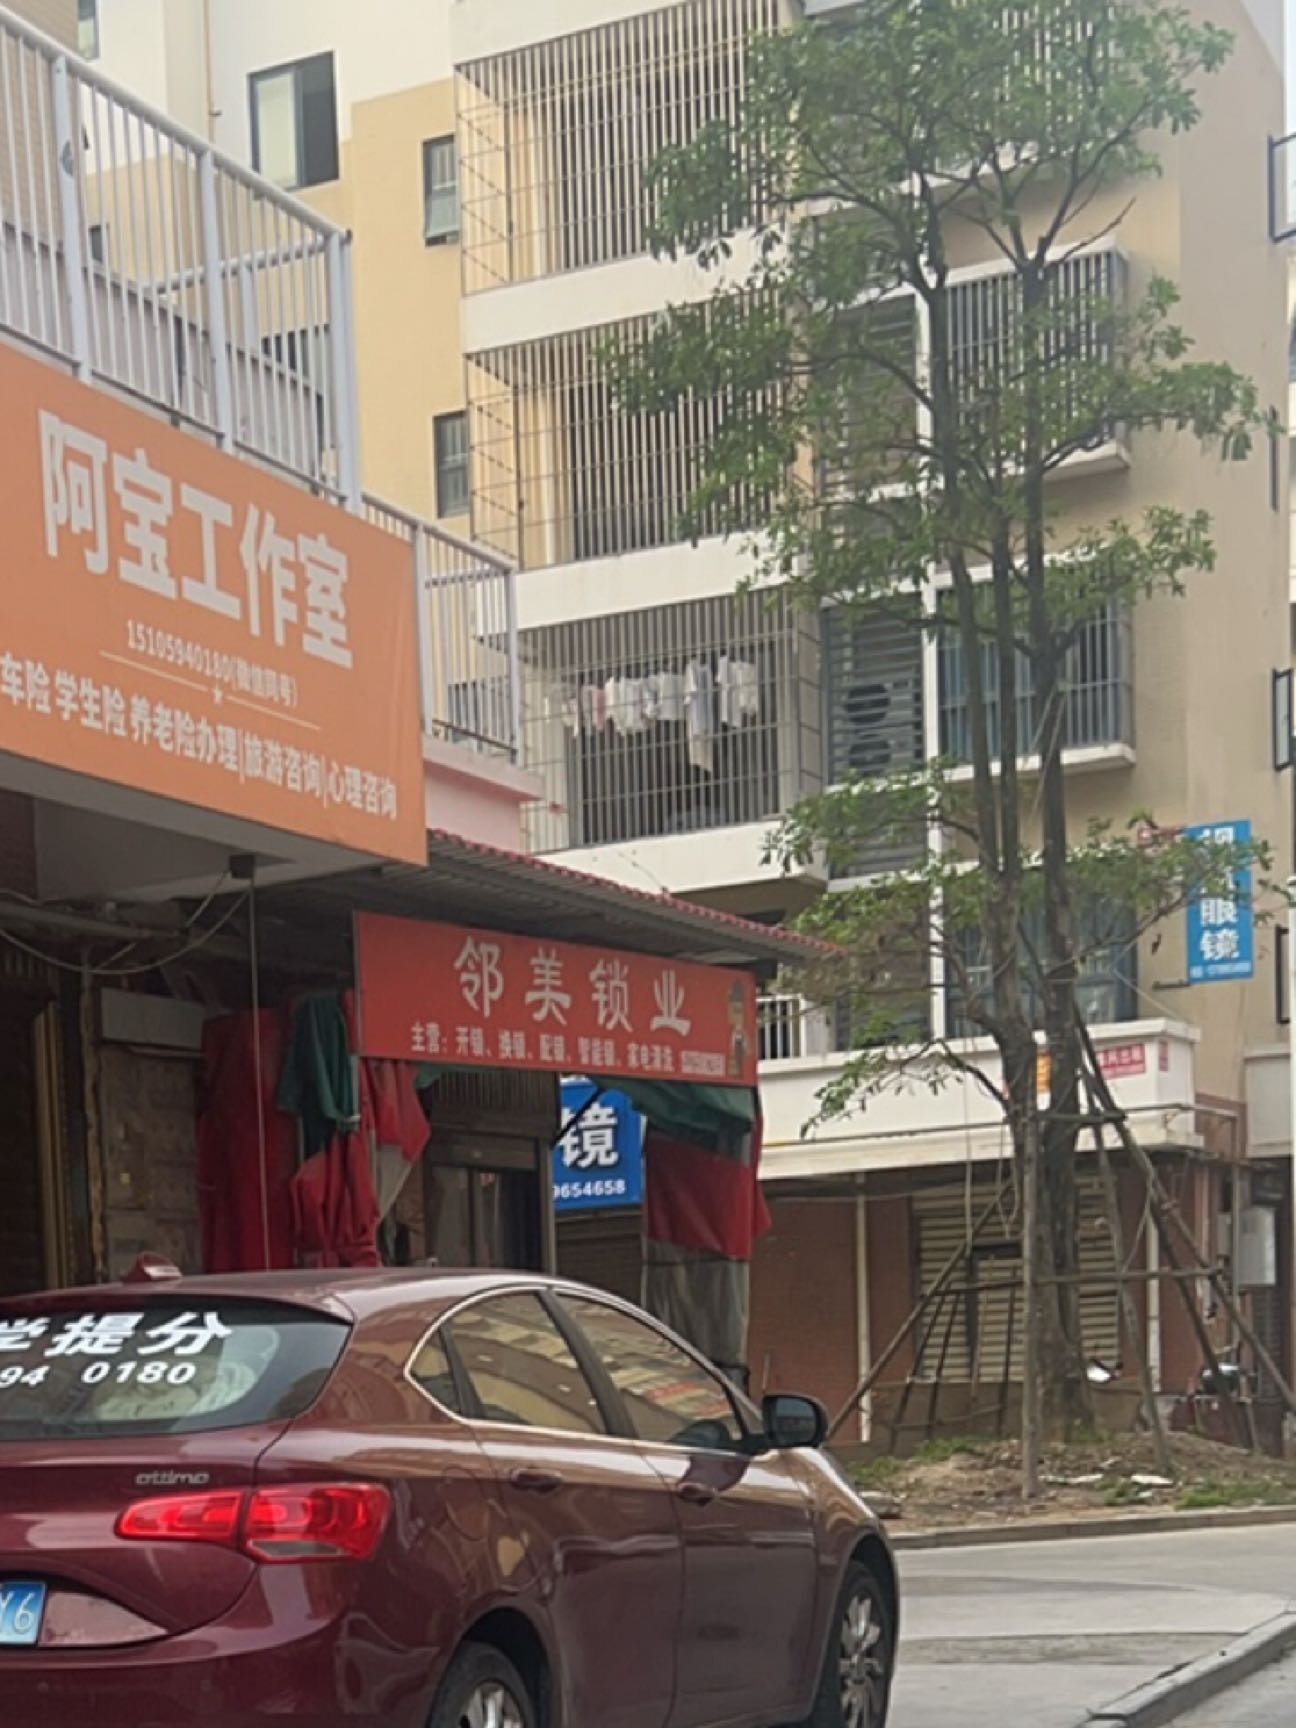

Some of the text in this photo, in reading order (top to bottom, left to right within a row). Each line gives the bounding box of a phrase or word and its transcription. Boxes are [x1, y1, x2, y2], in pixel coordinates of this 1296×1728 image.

[37, 408, 354, 670] 阿宝工作室
[0, 652, 51, 714] 车险
[54, 667, 127, 738] 学生险
[452, 935, 692, 1037] 邻美锁业
[559, 1102, 619, 1168] 镜
[79, 1360, 197, 1385] 0180
